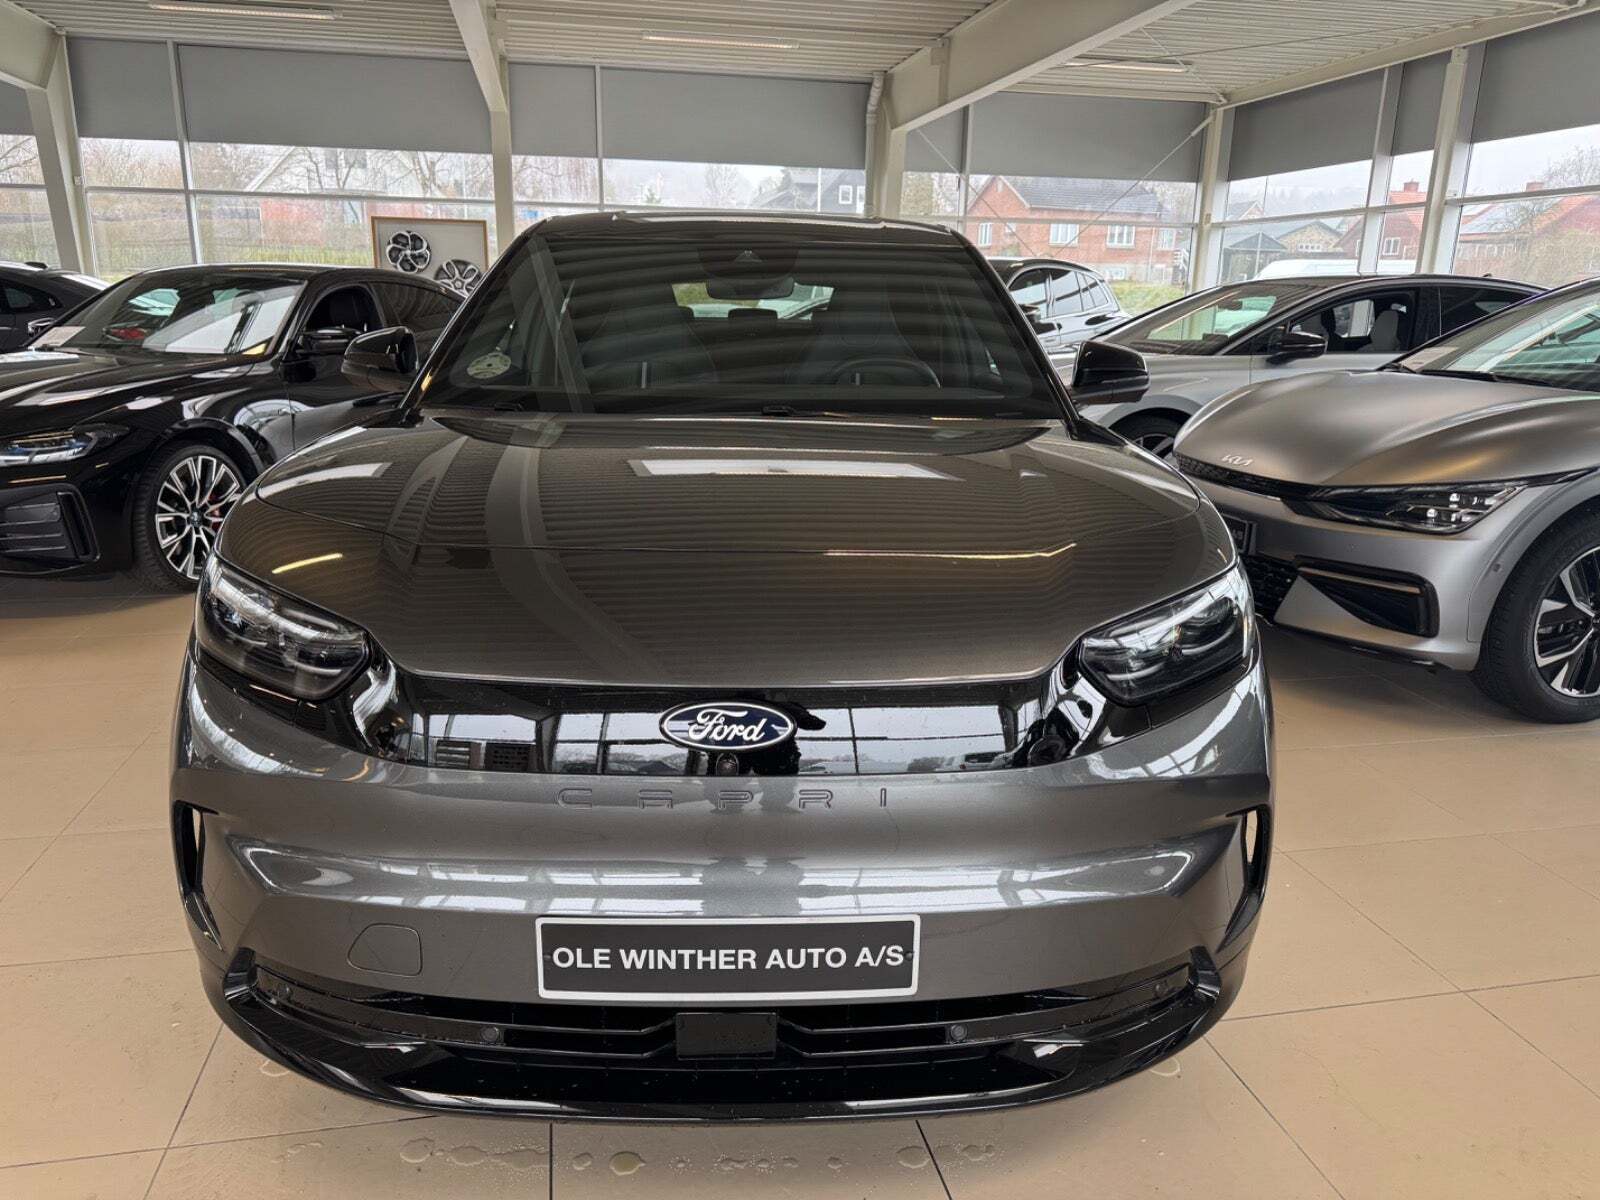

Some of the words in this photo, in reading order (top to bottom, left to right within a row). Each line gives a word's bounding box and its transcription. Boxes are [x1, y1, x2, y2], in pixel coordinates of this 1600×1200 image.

[689, 708, 767, 741] Ford
[557, 788, 887, 809] CAPRI
[552, 947, 611, 969] OLE
[619, 948, 757, 970] WINTHER
[765, 947, 847, 969] AUTO
[854, 945, 904, 967] A/S
